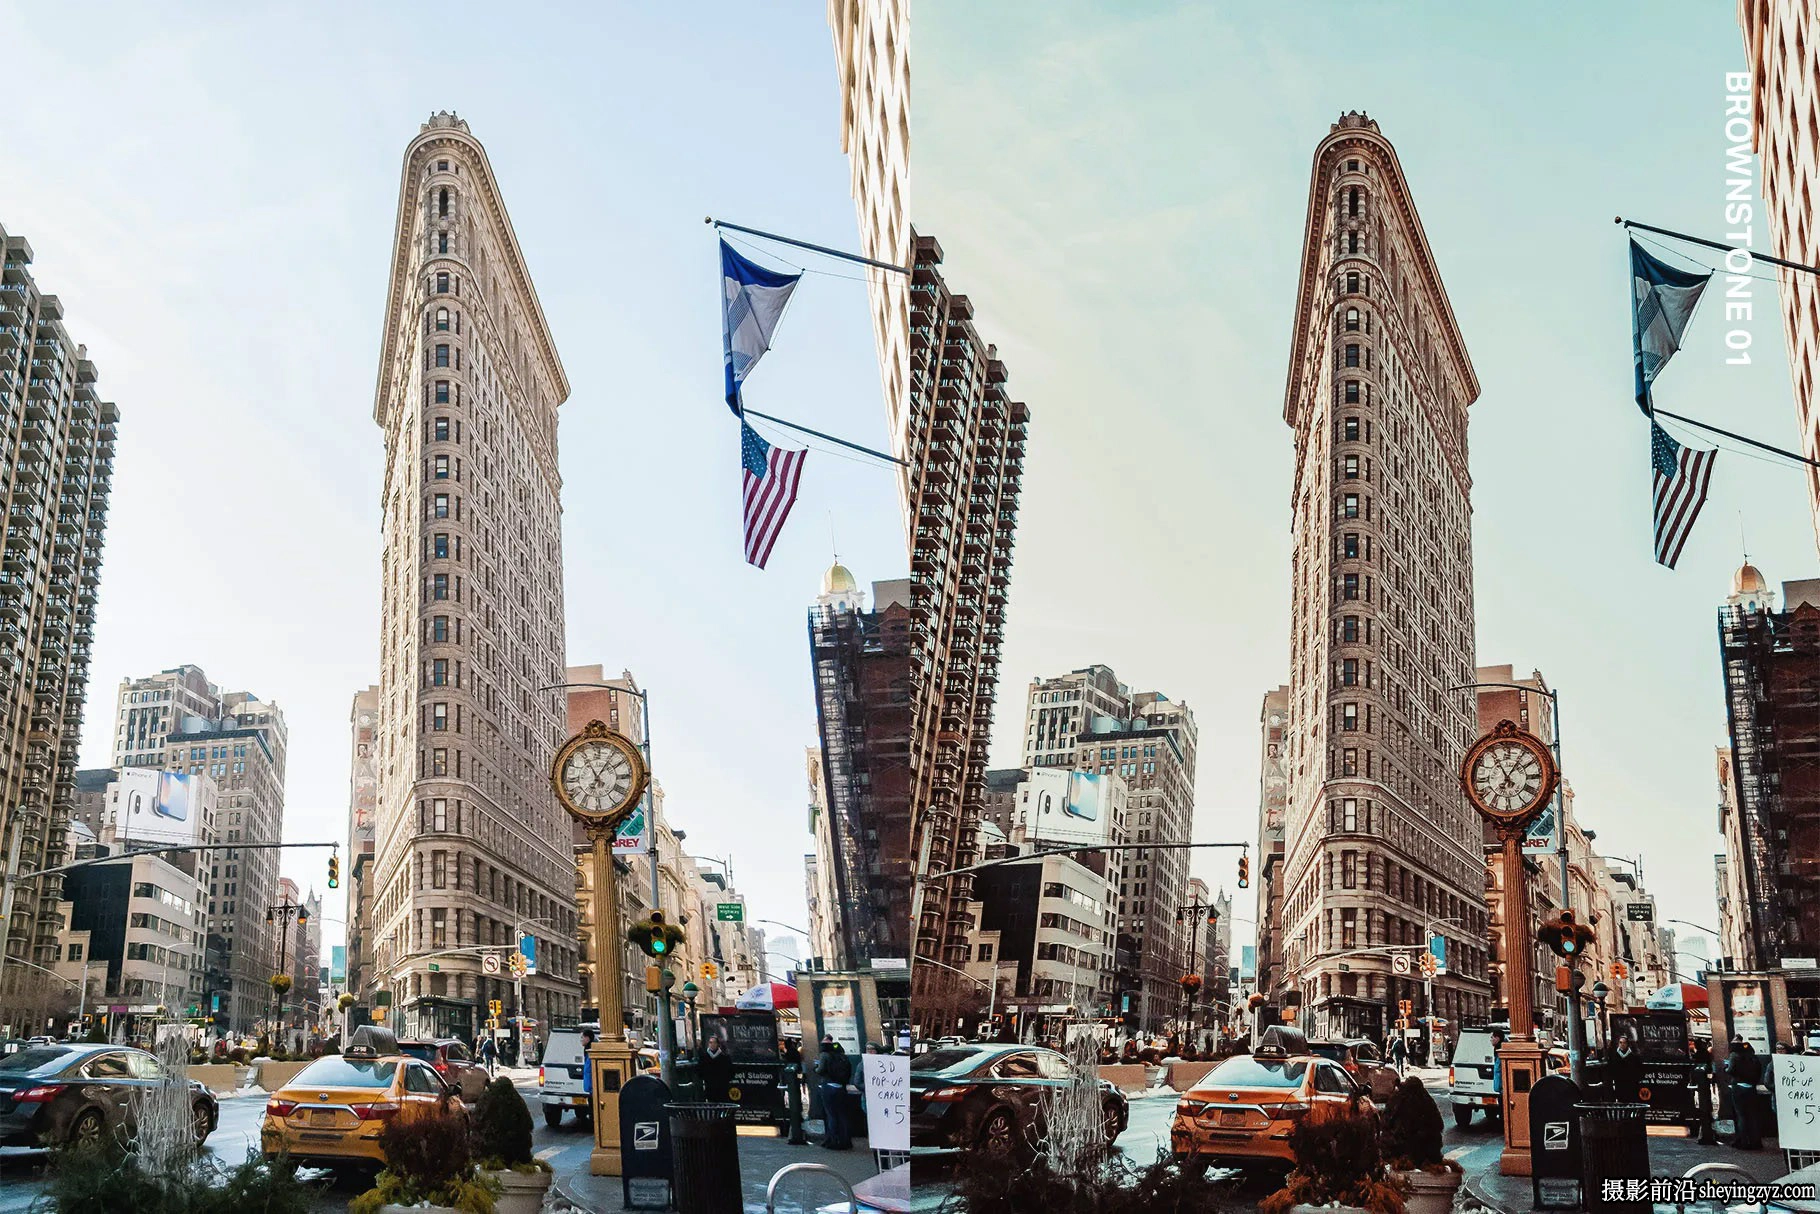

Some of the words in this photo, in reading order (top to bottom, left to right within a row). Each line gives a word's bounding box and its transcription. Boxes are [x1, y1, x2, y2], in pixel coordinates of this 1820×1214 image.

[747, 1071, 773, 1079] Station
[1657, 1071, 1683, 1079] Station
[871, 1076, 903, 1087] POP-UP
[1781, 1076, 1813, 1087] POP-UP
[877, 1091, 904, 1101] CARDS
[1787, 1091, 1814, 1101] CARDS
